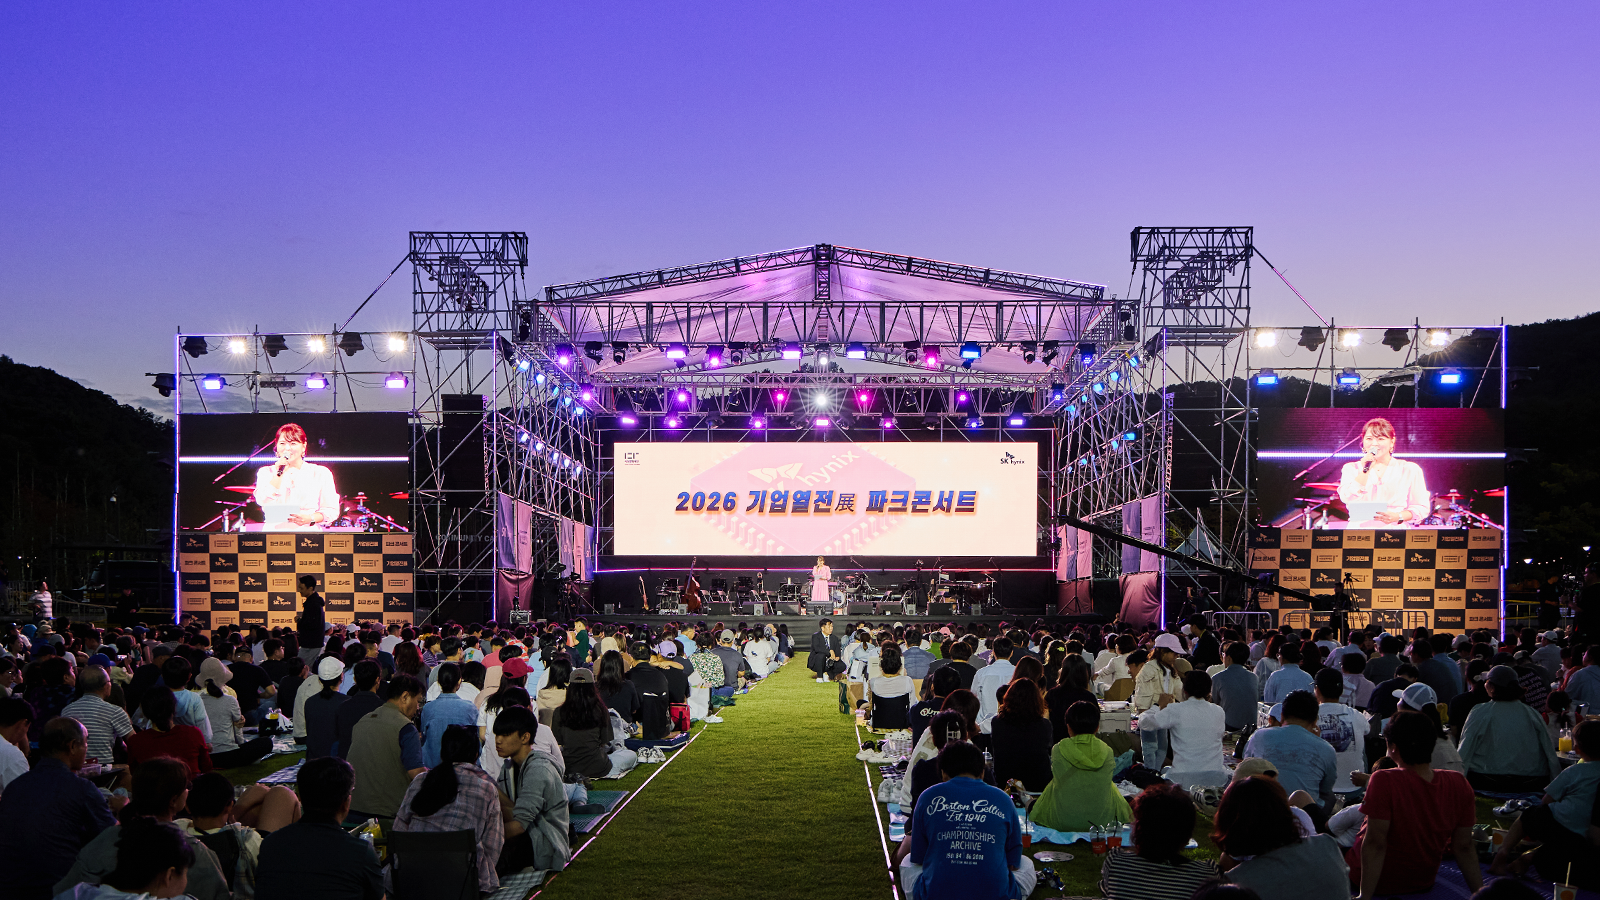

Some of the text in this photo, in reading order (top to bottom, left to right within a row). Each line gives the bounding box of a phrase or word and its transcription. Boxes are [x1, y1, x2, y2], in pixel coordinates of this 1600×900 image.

[796, 450, 860, 486] hynix
[675, 490, 978, 514] 2026 기업열전展 파크콘서트
[926, 795, 970, 816] Boston
[965, 813, 986, 823] 1946
[937, 830, 995, 844] CHAMPIONSHIPS
[950, 841, 982, 850] ARCHIVE
